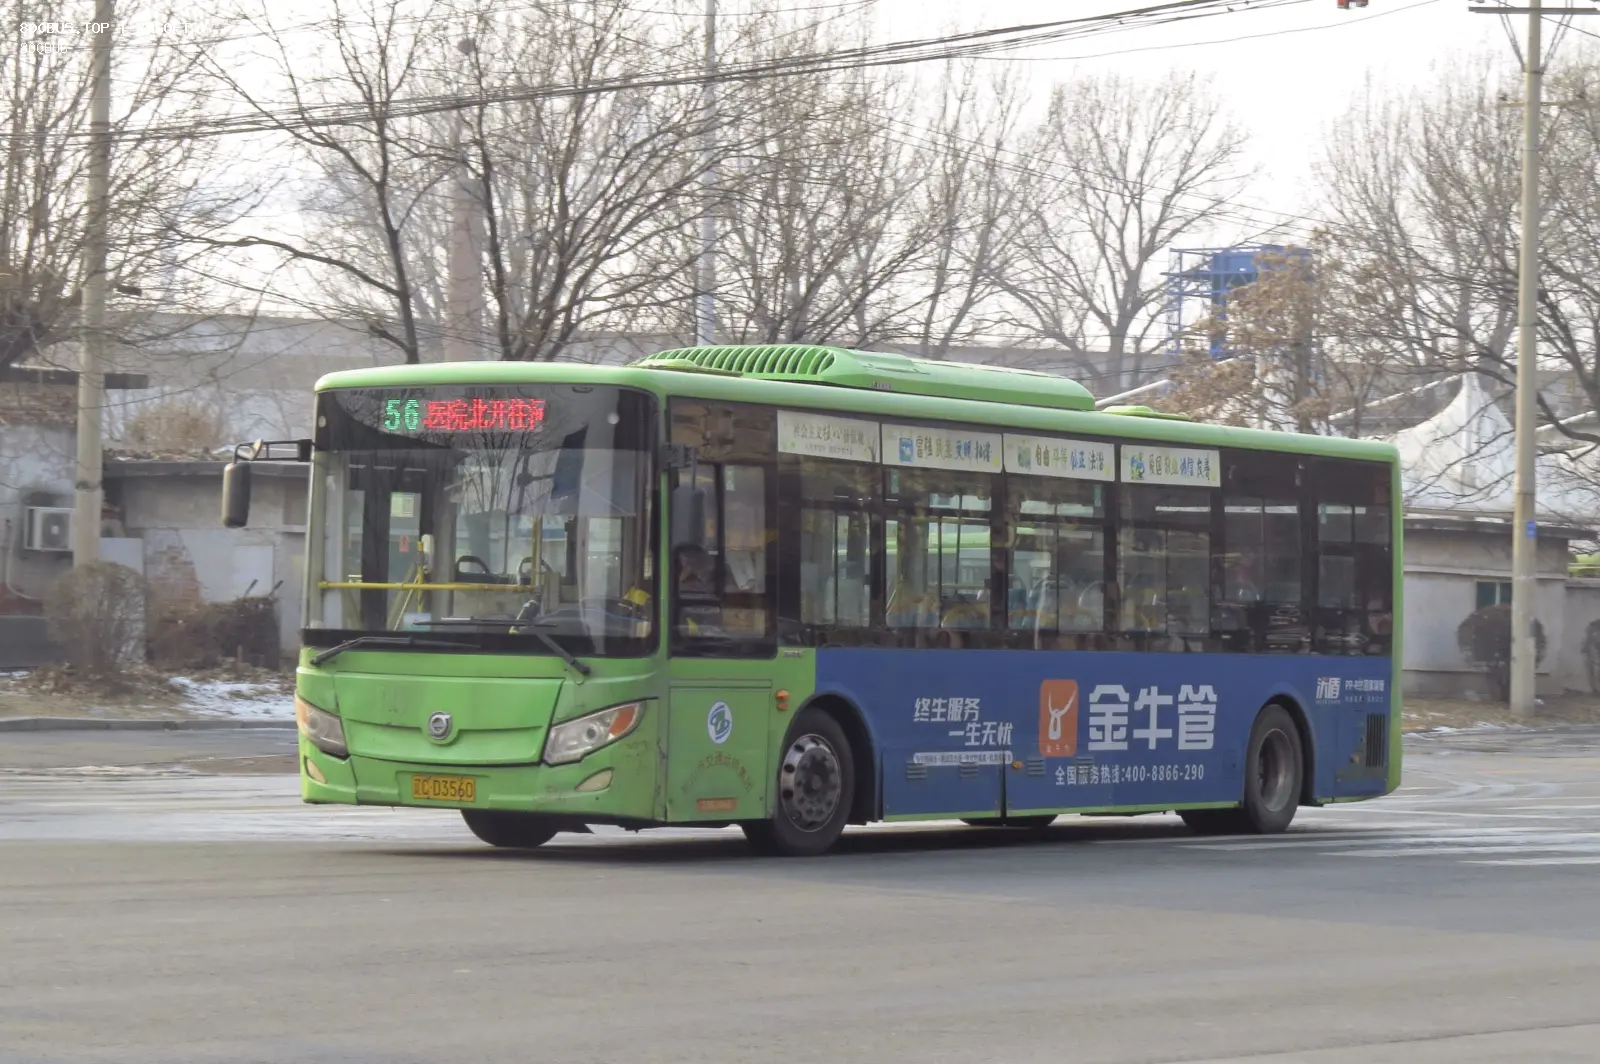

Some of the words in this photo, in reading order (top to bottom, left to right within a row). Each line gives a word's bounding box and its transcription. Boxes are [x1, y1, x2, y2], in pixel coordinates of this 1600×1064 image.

[384, 399, 420, 430] 56
[913, 697, 981, 722] 终生服务
[1087, 684, 1218, 751] 金牛管
[948, 721, 1014, 746] 一生无忧
